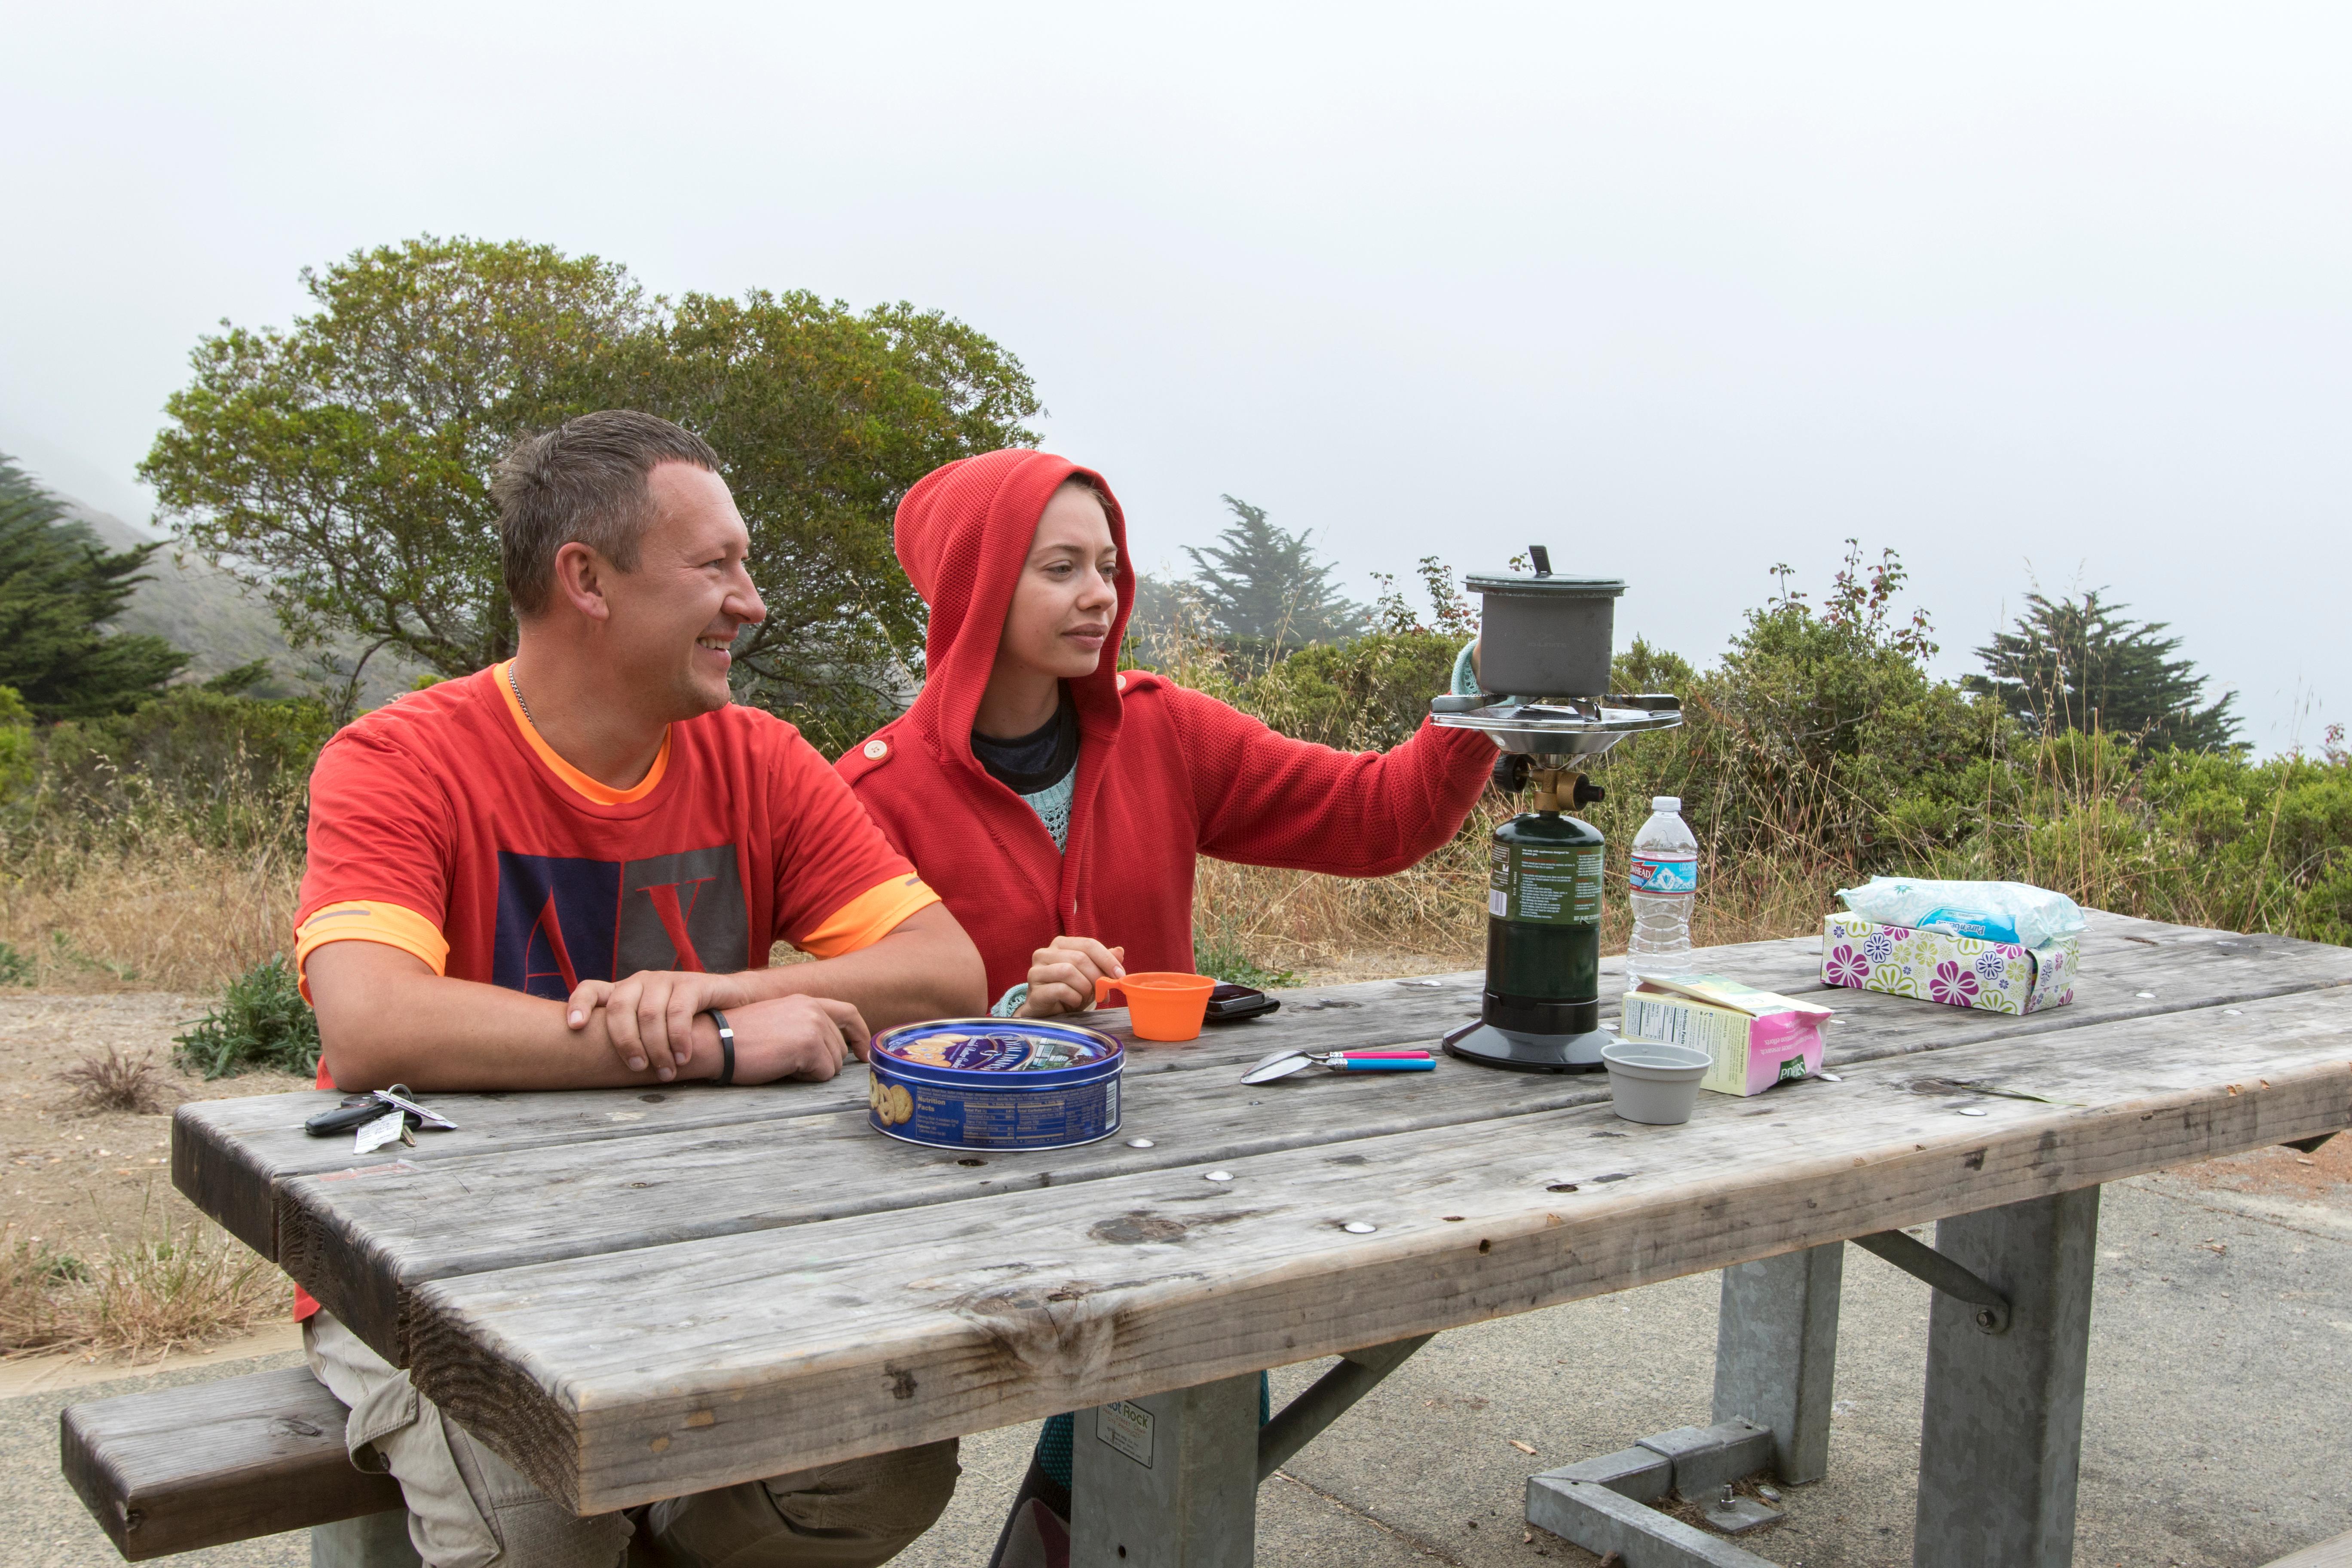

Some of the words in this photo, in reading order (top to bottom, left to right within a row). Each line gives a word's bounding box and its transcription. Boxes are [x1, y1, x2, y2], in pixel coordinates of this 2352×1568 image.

[524, 885, 579, 995] A
[636, 877, 716, 972] X
[951, 1057, 969, 1068] Cookie
[979, 1054, 1019, 1070] DANS
[918, 1096, 946, 1106] Nutrition
[918, 1104, 934, 1112] Facts
[1107, 1417, 1116, 1425] SITE
[1116, 1415, 1130, 1426] STREET
[1124, 1404, 1148, 1429] Rock
